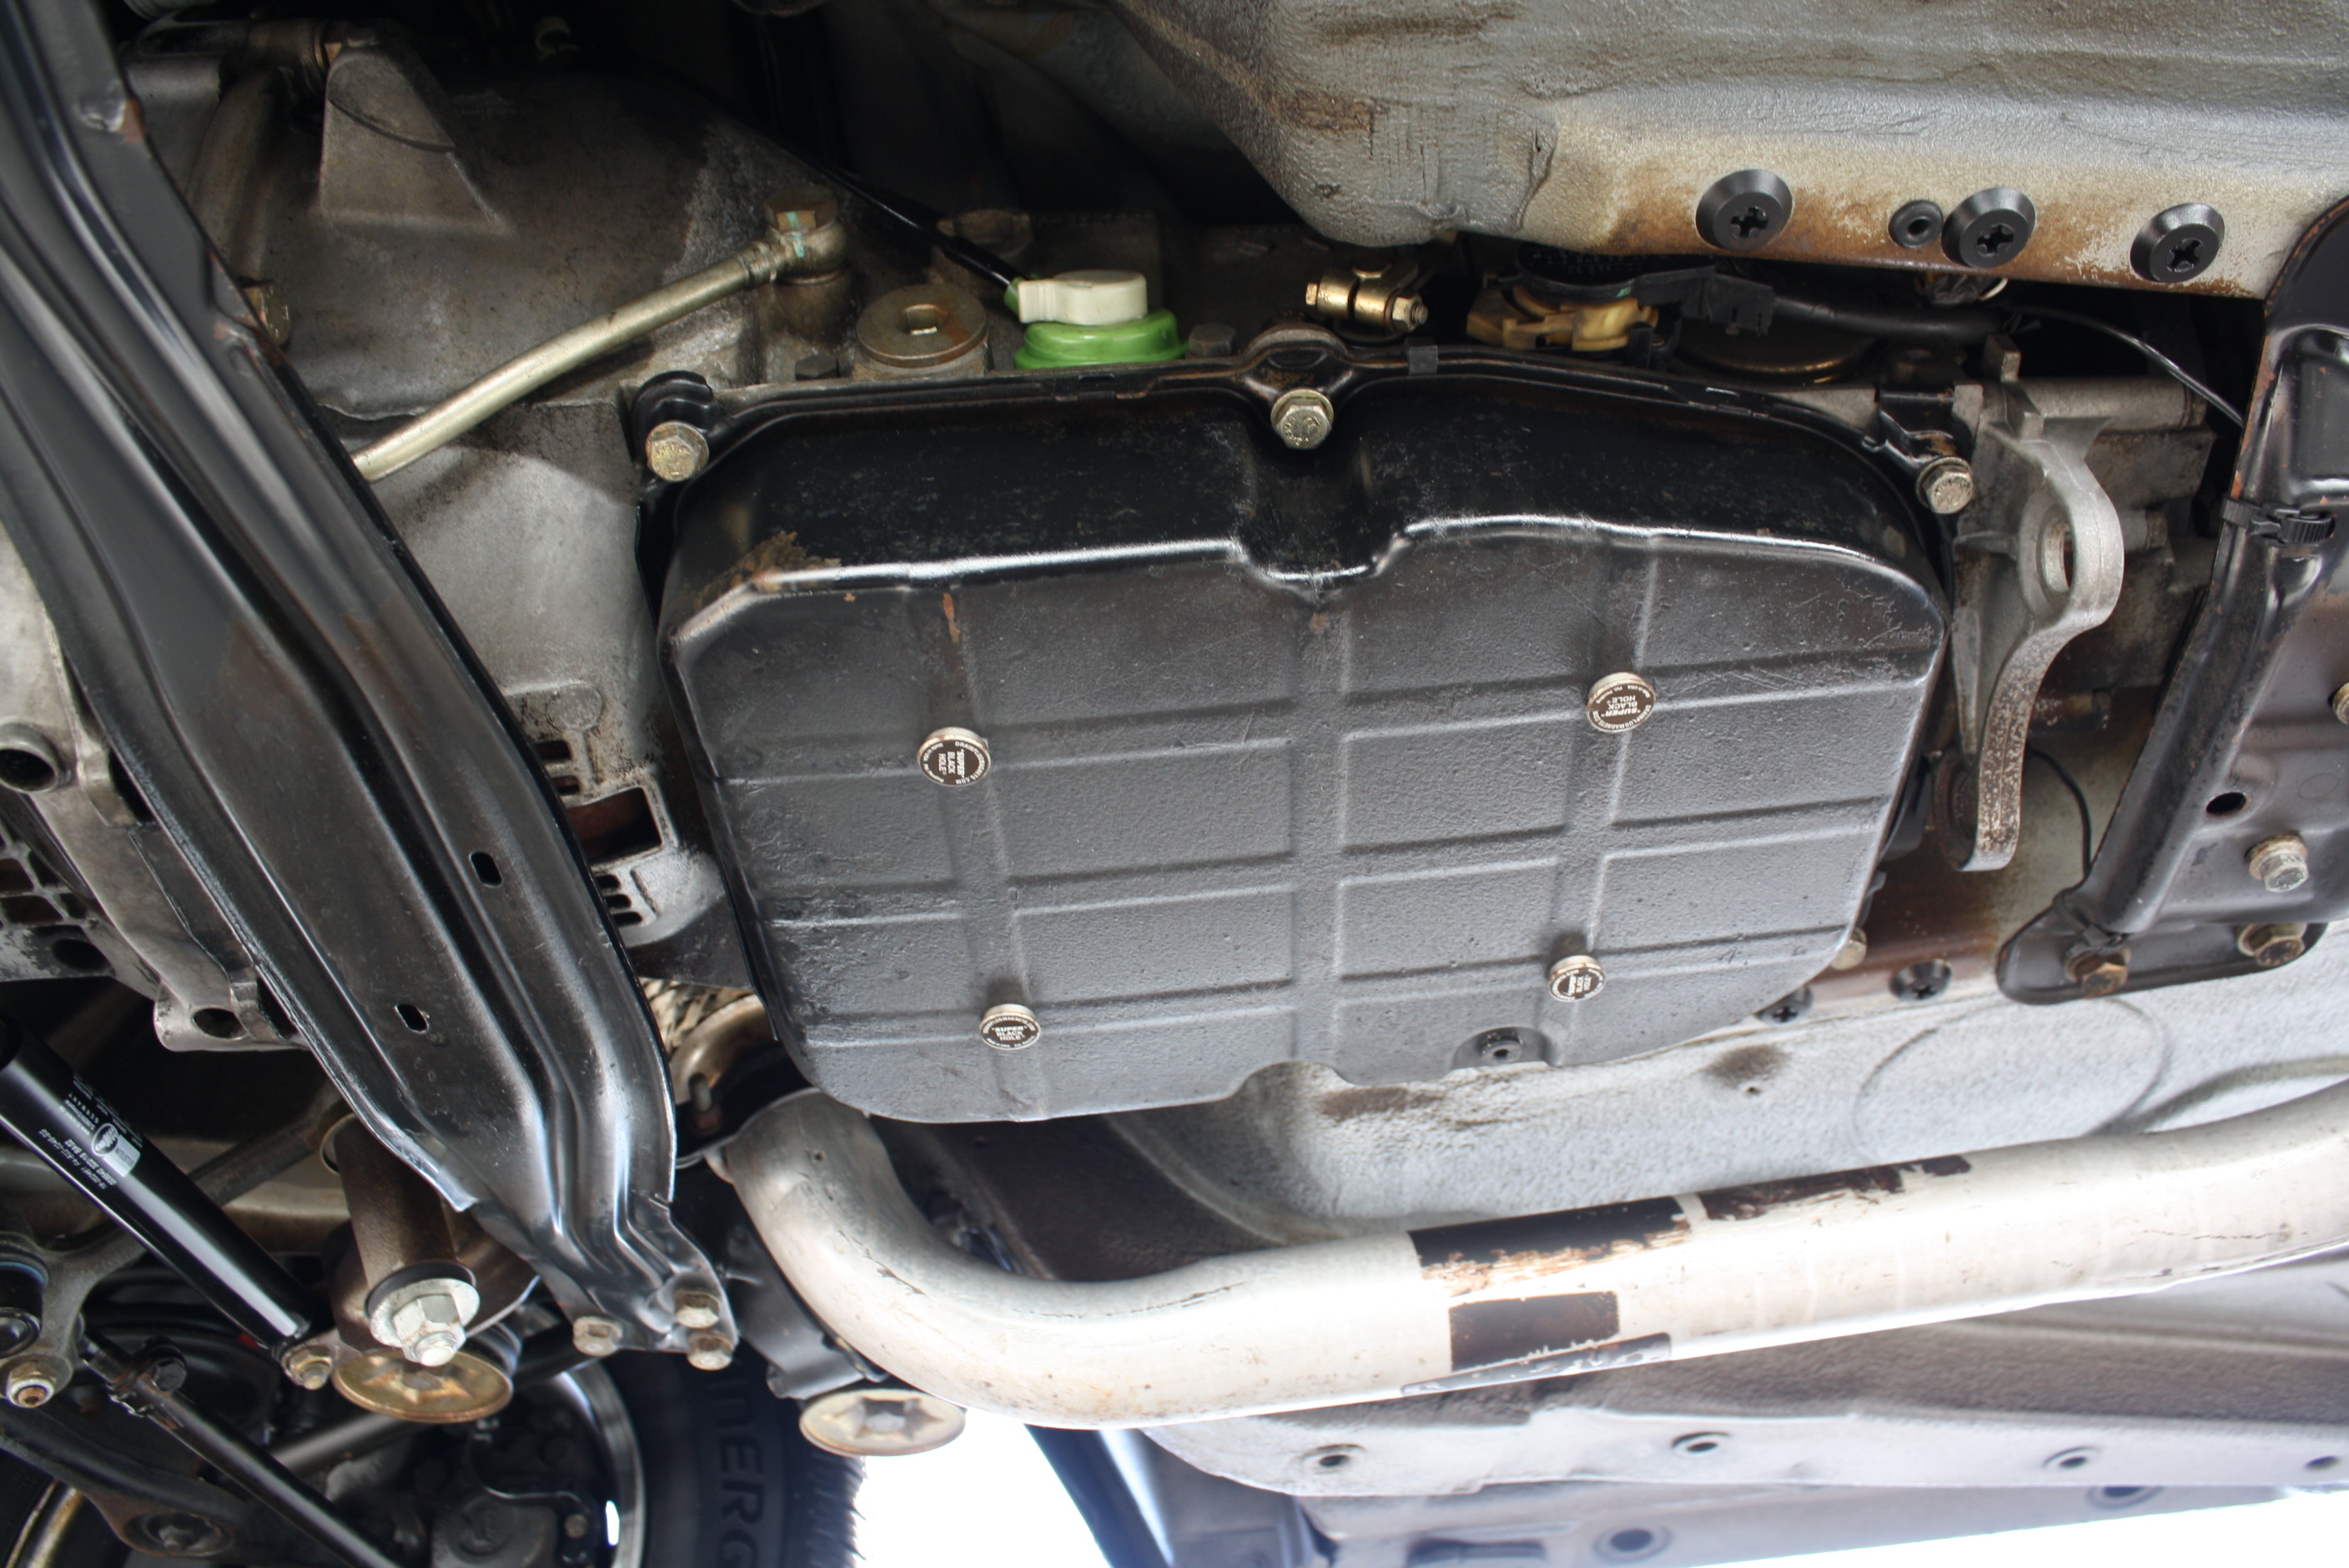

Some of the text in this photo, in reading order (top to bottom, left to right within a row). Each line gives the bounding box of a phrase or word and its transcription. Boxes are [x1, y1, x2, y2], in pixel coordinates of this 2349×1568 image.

[1601, 707, 1641, 717] "SUPER"
[1607, 701, 1637, 711] BLACK
[947, 751, 956, 775] BLACK
[956, 749, 964, 779] "SUPER"
[707, 1362, 765, 1568] INERG
